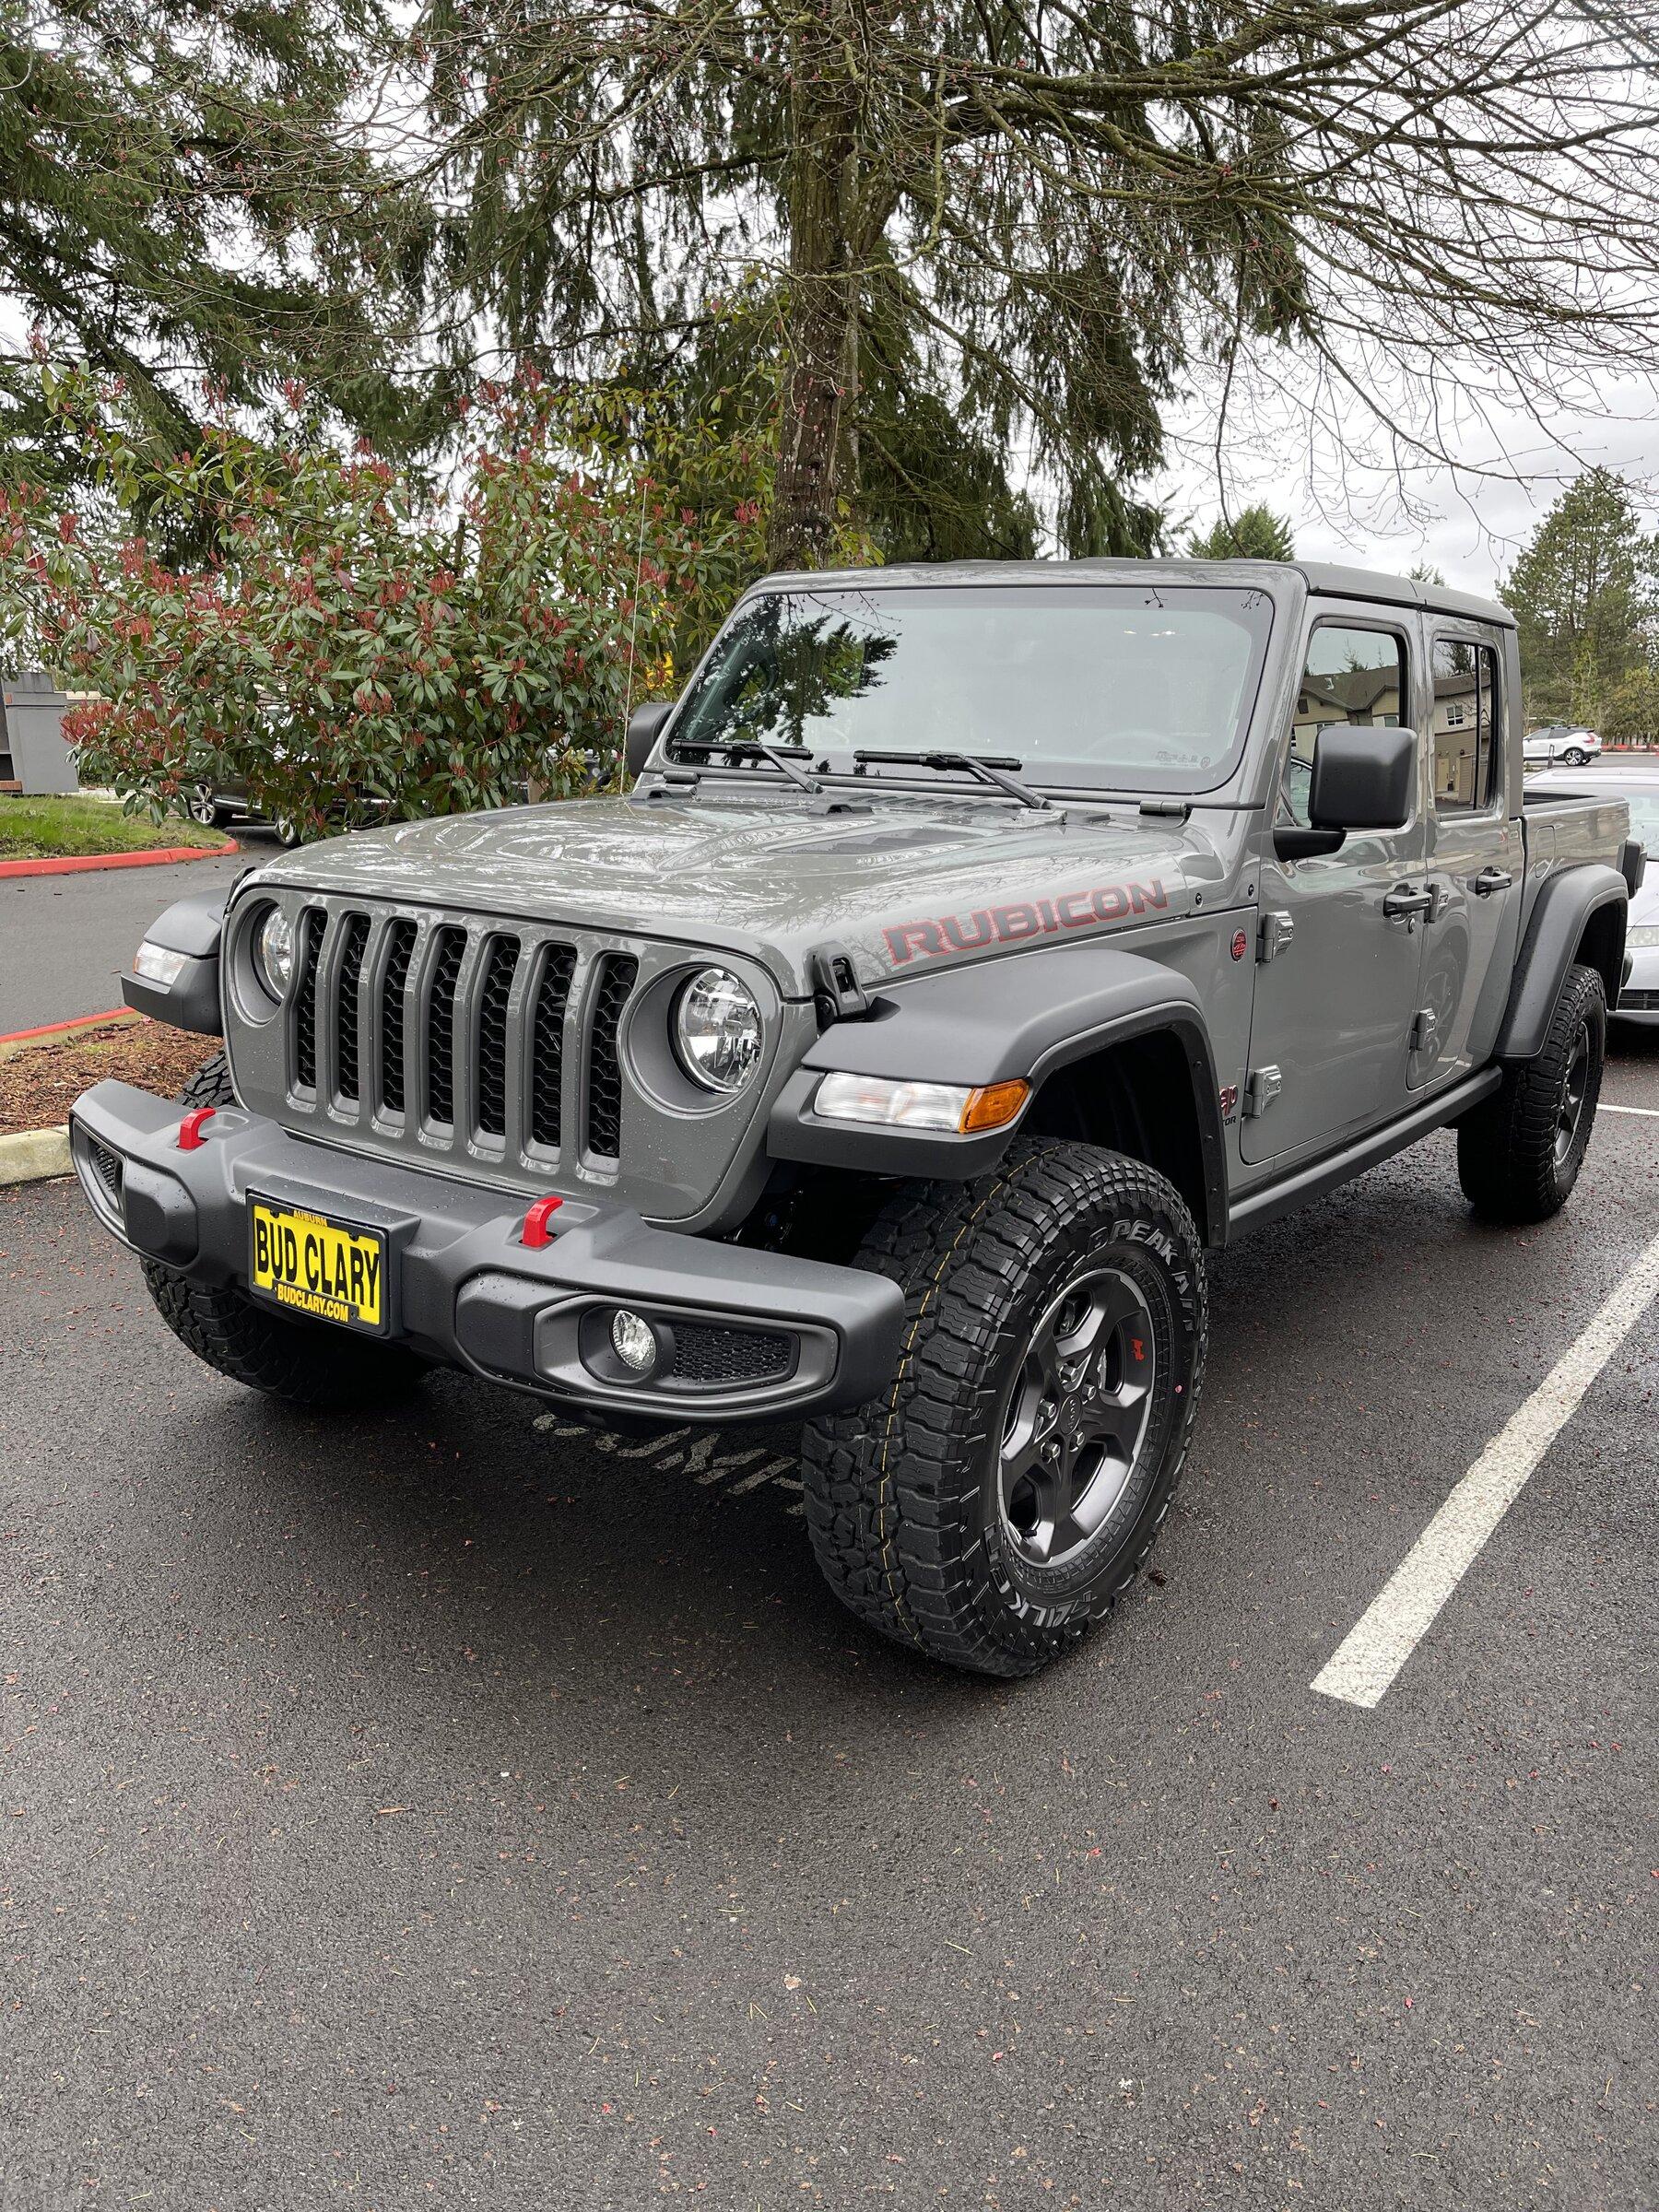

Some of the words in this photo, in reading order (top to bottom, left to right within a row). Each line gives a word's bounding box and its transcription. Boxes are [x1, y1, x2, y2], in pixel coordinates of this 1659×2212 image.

[882, 879, 1169, 965] RUBICON
[293, 1210, 328, 1227] AUBURN
[255, 1218, 298, 1283] BUD
[304, 1233, 380, 1309] CLARY
[277, 1284, 348, 1323] BUDCLARY.COM
